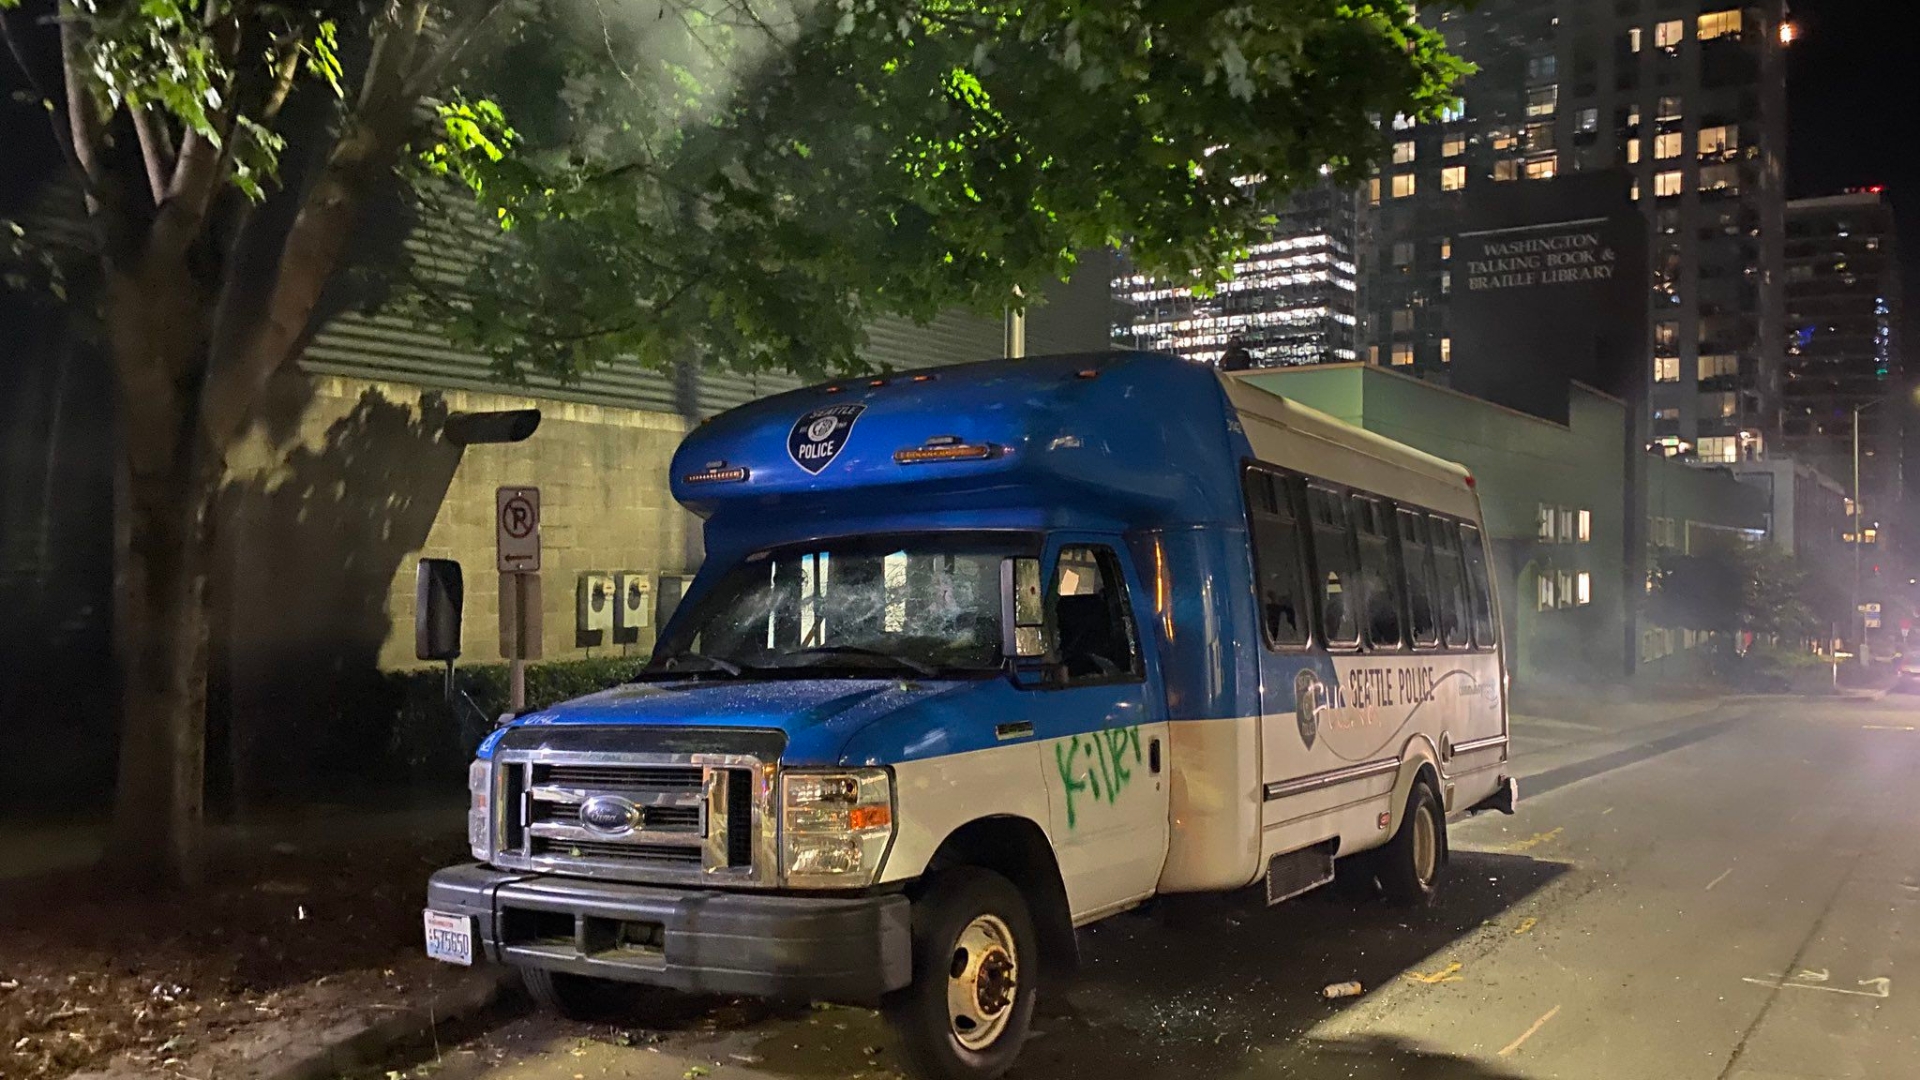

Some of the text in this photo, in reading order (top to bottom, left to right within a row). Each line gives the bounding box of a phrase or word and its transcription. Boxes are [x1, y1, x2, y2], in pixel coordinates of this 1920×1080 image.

[1484, 234, 1598, 256] WASHINGTON
[1468, 248, 1615, 274] TALKING BOOK &
[1542, 266, 1614, 283] LIBRARY
[809, 406, 856, 418] SEATTLE
[798, 440, 835, 459] POLICE
[1349, 668, 1394, 709] SEATTLE
[1399, 666, 1436, 705] POLICE
